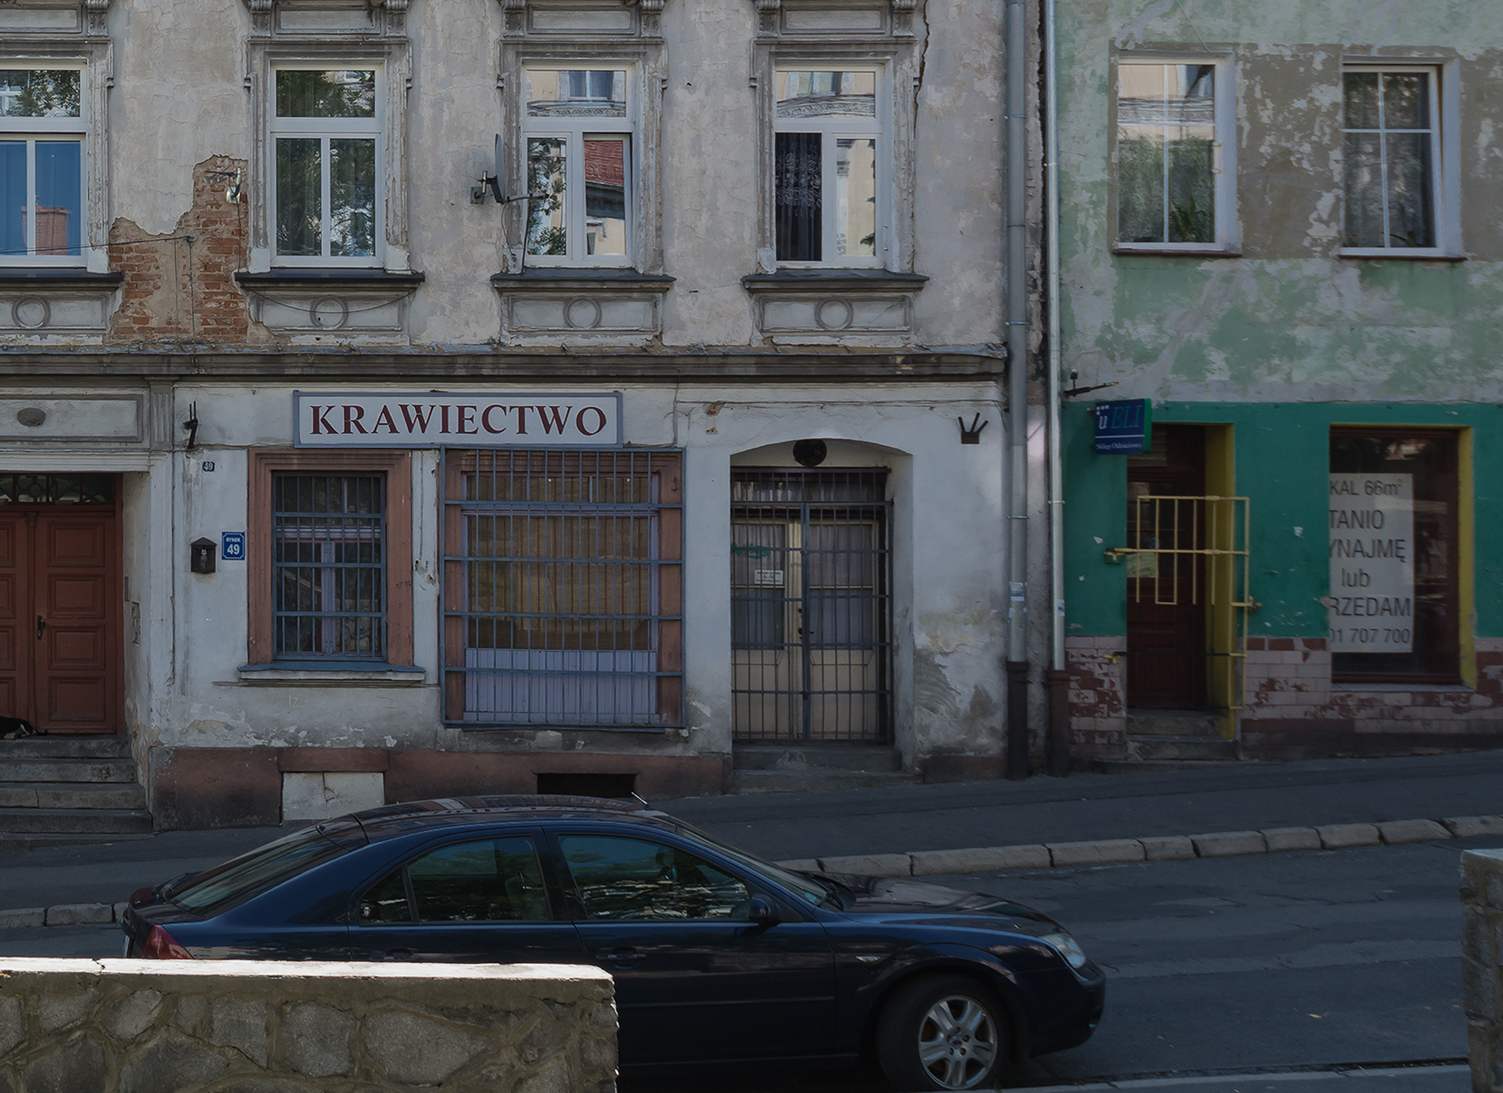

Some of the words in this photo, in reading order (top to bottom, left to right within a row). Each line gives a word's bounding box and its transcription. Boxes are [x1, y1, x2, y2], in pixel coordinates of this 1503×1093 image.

[309, 403, 607, 437] KRAWIECTWO
[1110, 405, 1142, 429] ELI
[1329, 480, 1360, 496] KAL
[1329, 509, 1385, 530] TANIO
[226, 543, 241, 555] 49
[1329, 538, 1406, 563] YNAJMĘ
[1341, 567, 1371, 588] lub
[1329, 596, 1411, 617] RZEDAM
[1349, 627, 1379, 644] 707
[1383, 627, 1411, 644] 700
